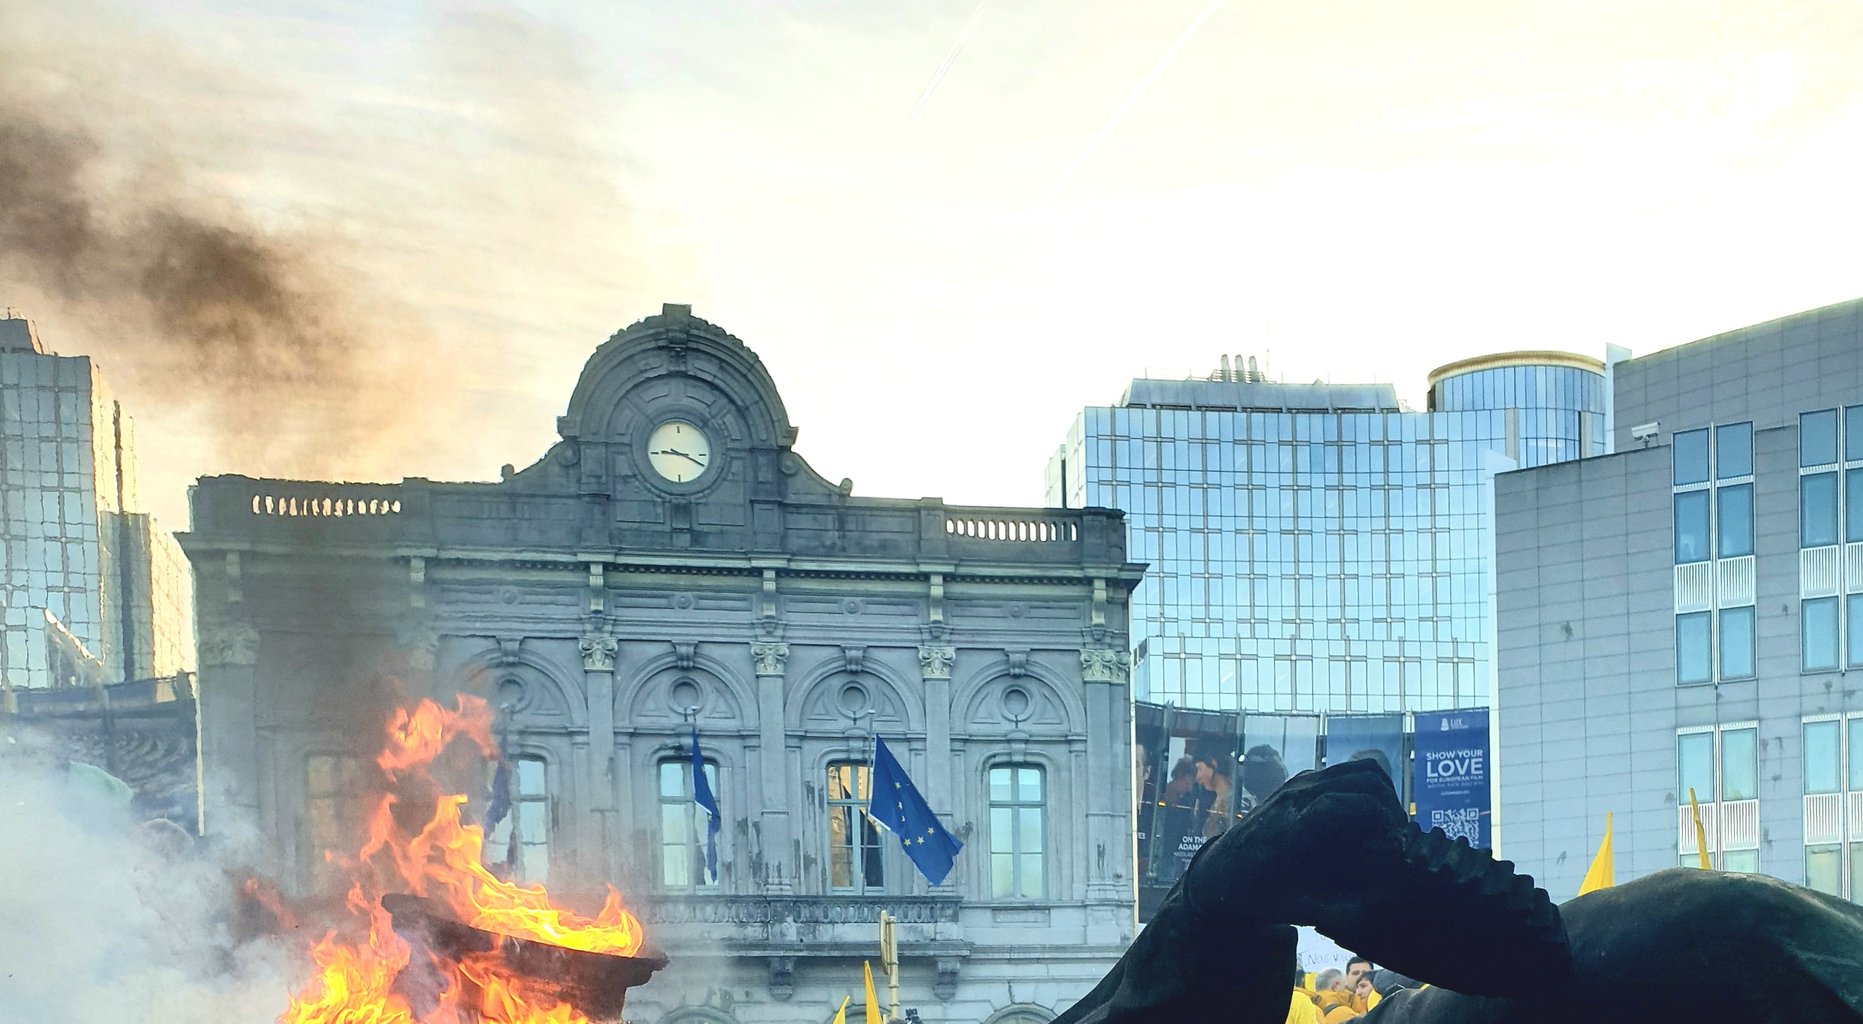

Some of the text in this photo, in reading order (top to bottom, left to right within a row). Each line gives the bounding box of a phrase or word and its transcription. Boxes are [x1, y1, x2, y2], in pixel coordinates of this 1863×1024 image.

[1426, 749, 1483, 761] SHOW YOUR
[1427, 758, 1483, 777] LOVE
[1194, 836, 1207, 844] THE
